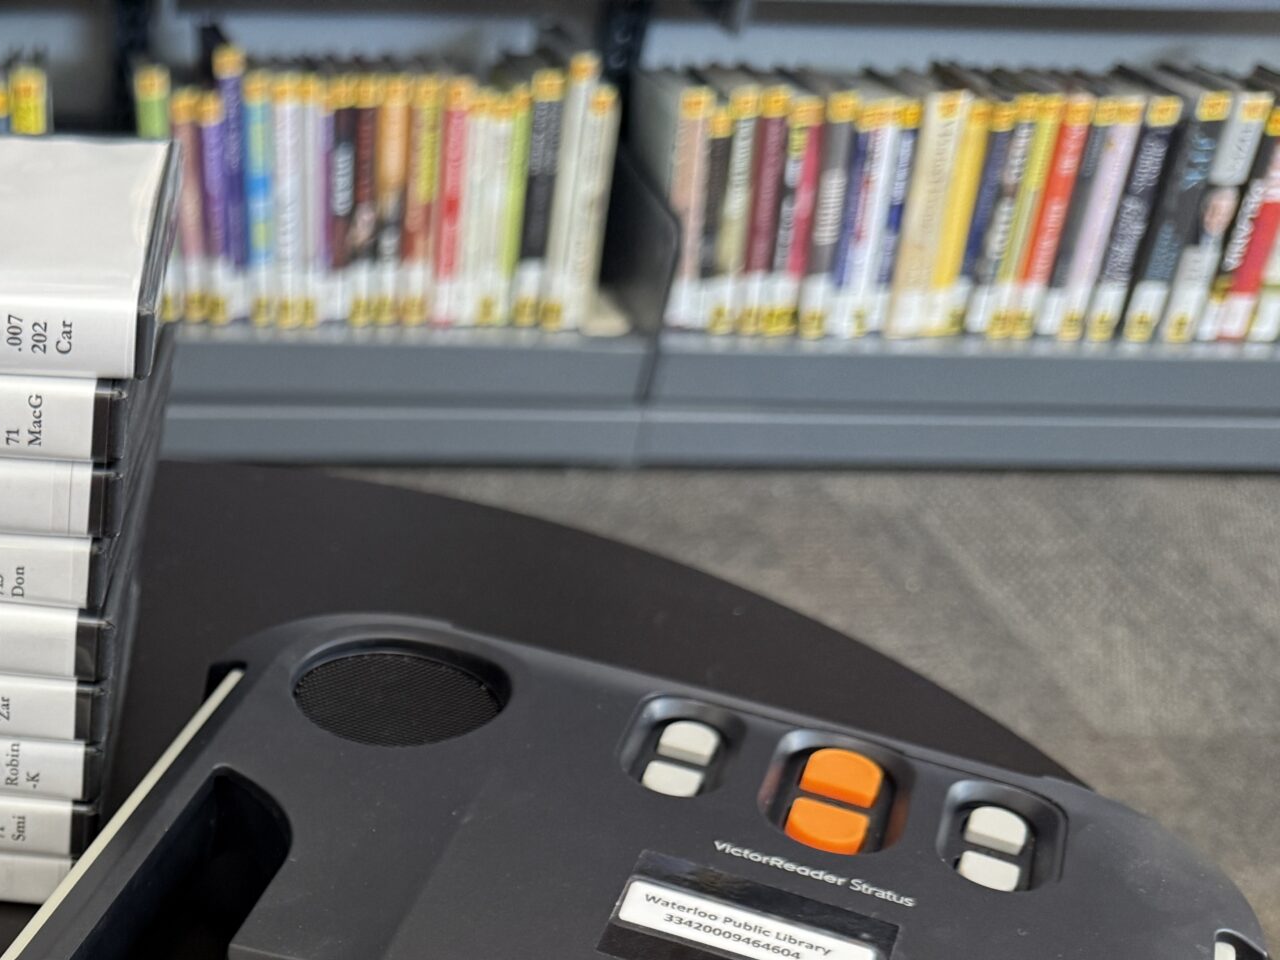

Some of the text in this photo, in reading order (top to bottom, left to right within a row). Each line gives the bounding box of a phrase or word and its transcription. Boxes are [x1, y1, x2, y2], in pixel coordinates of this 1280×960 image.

[6, 313, 24, 352] .007
[31, 321, 48, 354] 202
[55, 319, 73, 355] Car
[5, 428, 20, 446] 71
[27, 393, 43, 447] MacG
[10, 566, 25, 598] Don
[5, 742, 20, 787] Robin
[26, 771, 40, 790] -K
[11, 814, 26, 842] Smi
[713, 839, 917, 908] VictorReader Stratus
[644, 892, 833, 957] Waterloo Public Library
[663, 912, 802, 960] 33420009464604
